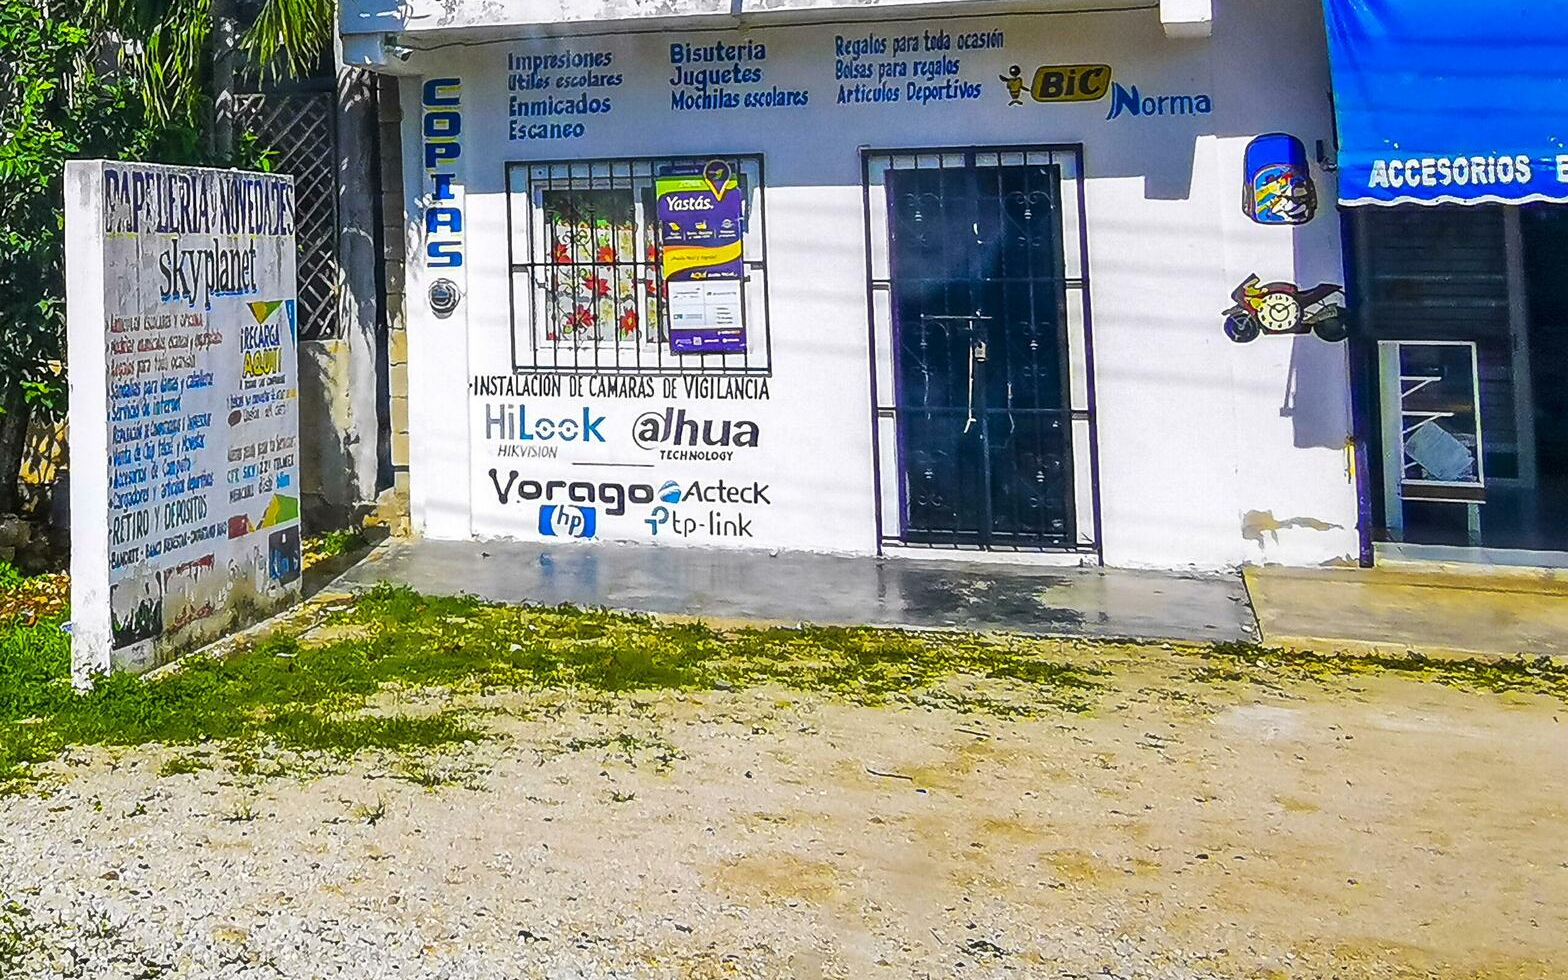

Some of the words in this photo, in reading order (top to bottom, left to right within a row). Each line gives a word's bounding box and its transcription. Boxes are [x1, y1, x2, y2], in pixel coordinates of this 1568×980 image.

[669, 39, 766, 64] Bisuteria
[835, 30, 887, 61] Regalos
[892, 35, 920, 57] para
[923, 29, 951, 52] toda
[957, 28, 1004, 51] ocasión
[508, 49, 613, 71] Impresiones
[835, 57, 874, 80] Bolsas
[878, 60, 907, 84] para
[913, 55, 960, 82] regalos
[556, 71, 623, 89] escolares
[669, 63, 762, 92] Juguetes
[508, 92, 611, 117] Enmicados
[671, 88, 740, 111] Mochilas
[744, 85, 809, 108] escolares
[1106, 82, 1212, 120] Norma
[508, 120, 585, 141] Escaneo
[422, 77, 463, 268] COPIAS
[1368, 154, 1532, 188] ACCESORIOS
[104, 169, 210, 234] PAPELERIA
[219, 176, 295, 235] NOVEDADES
[159, 238, 256, 308] skyplanet
[569, 377, 583, 397] DE
[589, 376, 655, 398] CAMARAS
[663, 378, 677, 399] DE
[684, 376, 770, 400] VIGILANCIA
[485, 404, 606, 442] HiLook
[497, 445, 558, 458] HIKVISION
[660, 450, 733, 461] TECHNOLOGY
[488, 468, 654, 515] Vorago
[113, 509, 149, 546] RETIRO
[164, 494, 207, 530] DEPOSITOS
[556, 505, 582, 535] hp
[673, 510, 753, 538] tp-link
